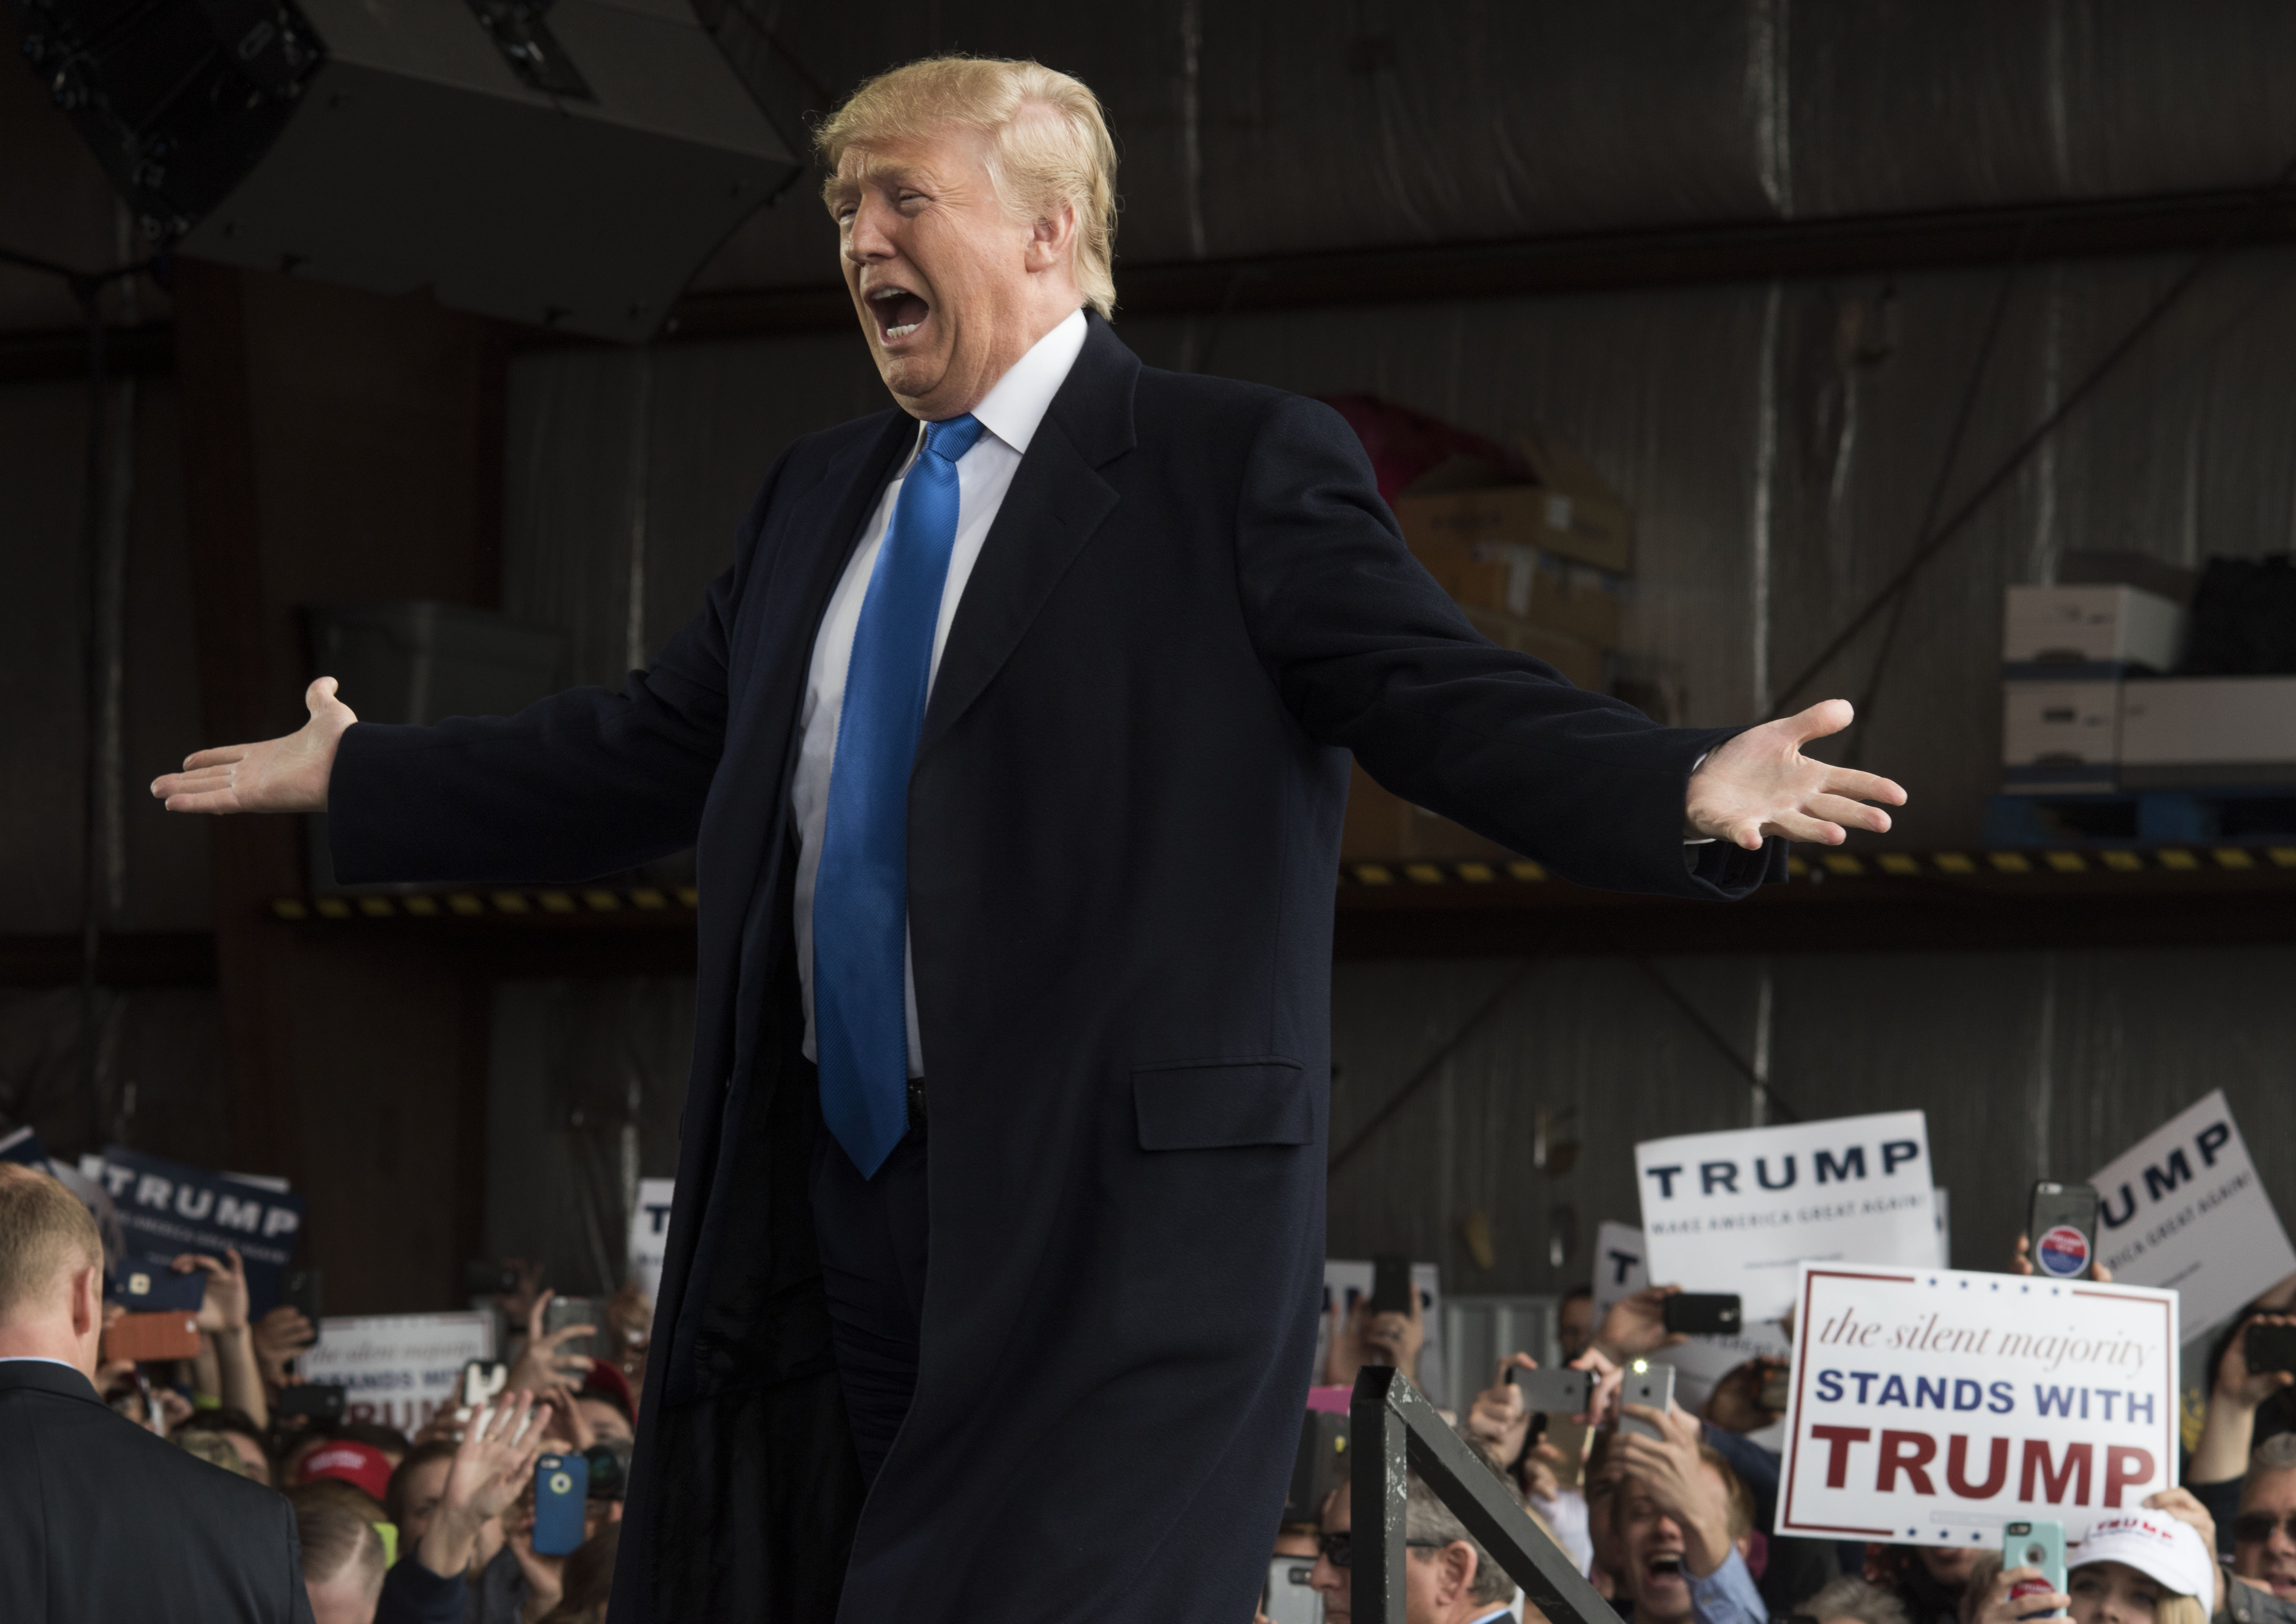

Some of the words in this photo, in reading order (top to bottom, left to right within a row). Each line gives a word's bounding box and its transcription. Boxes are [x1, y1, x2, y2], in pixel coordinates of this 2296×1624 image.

[104, 1164, 300, 1237] TRUMP
[1646, 1140, 1919, 1200] TRUMP
[2098, 1121, 2230, 1229] UMP
[1650, 1218, 1702, 1236] MAKE
[1708, 1210, 1792, 1232] AMERICA
[1797, 1201, 1856, 1223] GREAT
[2146, 1205, 2196, 1247] GREAT
[1819, 1307, 1881, 1347] the
[1887, 1313, 1994, 1354] silent
[1997, 1326, 2157, 1380] majority
[1815, 1369, 2015, 1413] STANDS
[2033, 1383, 2155, 1424] WITH
[1811, 1424, 2155, 1509] TRUMP
